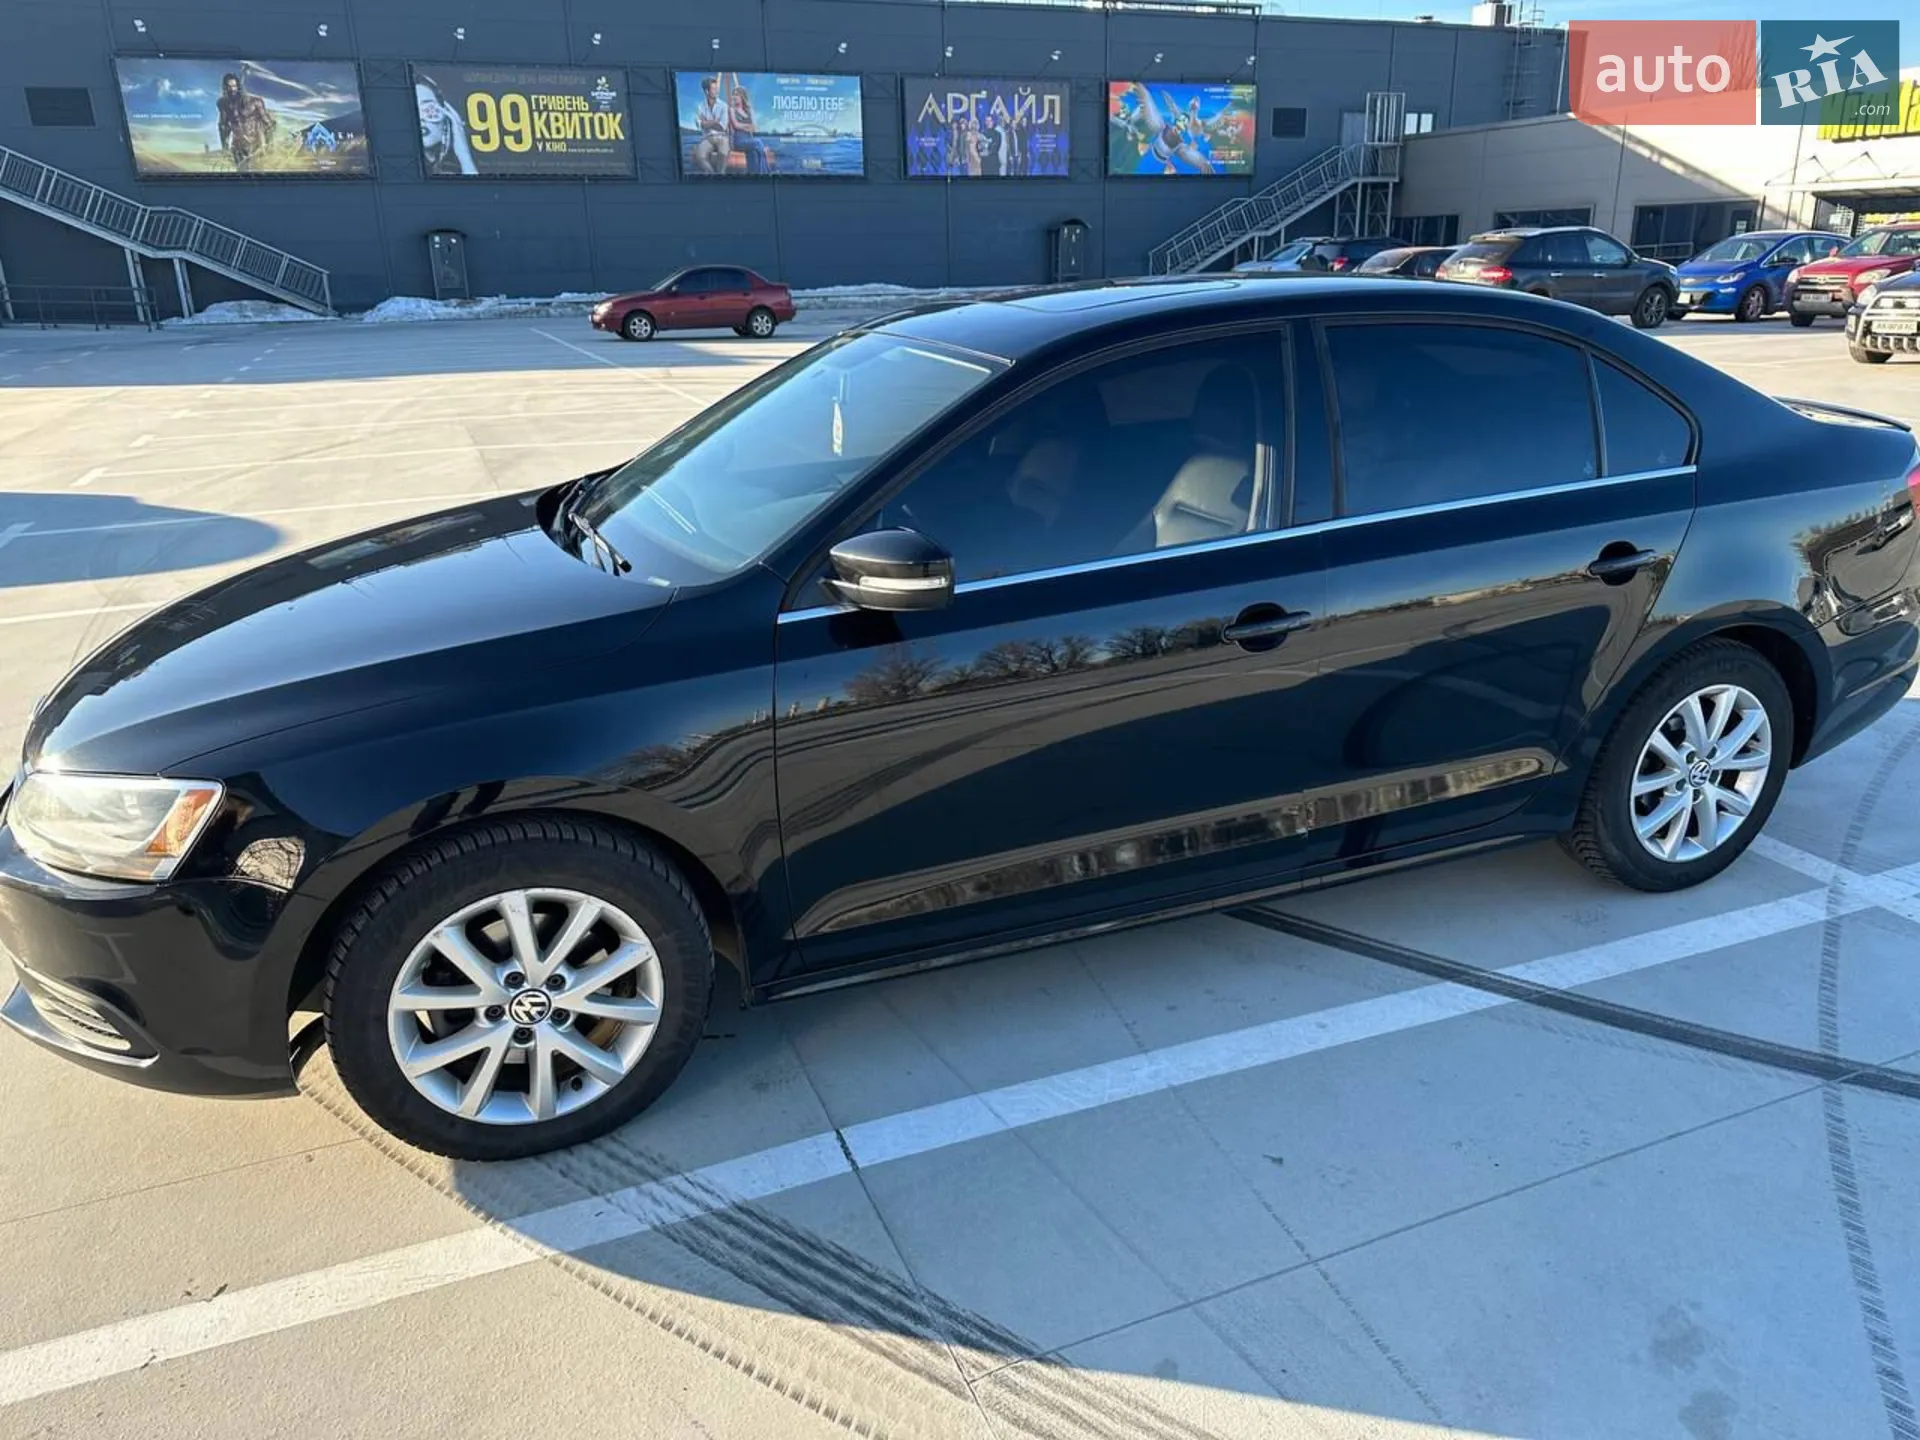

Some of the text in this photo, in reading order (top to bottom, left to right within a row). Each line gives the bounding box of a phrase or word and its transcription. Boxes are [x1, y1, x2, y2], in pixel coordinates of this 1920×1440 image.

[531, 95, 589, 111] ГРИВЕНЬ
[772, 95, 845, 110] ЛЮБЛЮ ТЕБЕ
[917, 86, 1061, 125] АРҐАЙЛ
[467, 92, 533, 152] 99
[533, 112, 625, 140] КВИТОК
[536, 141, 544, 152] У
[545, 141, 567, 153] КІНО
